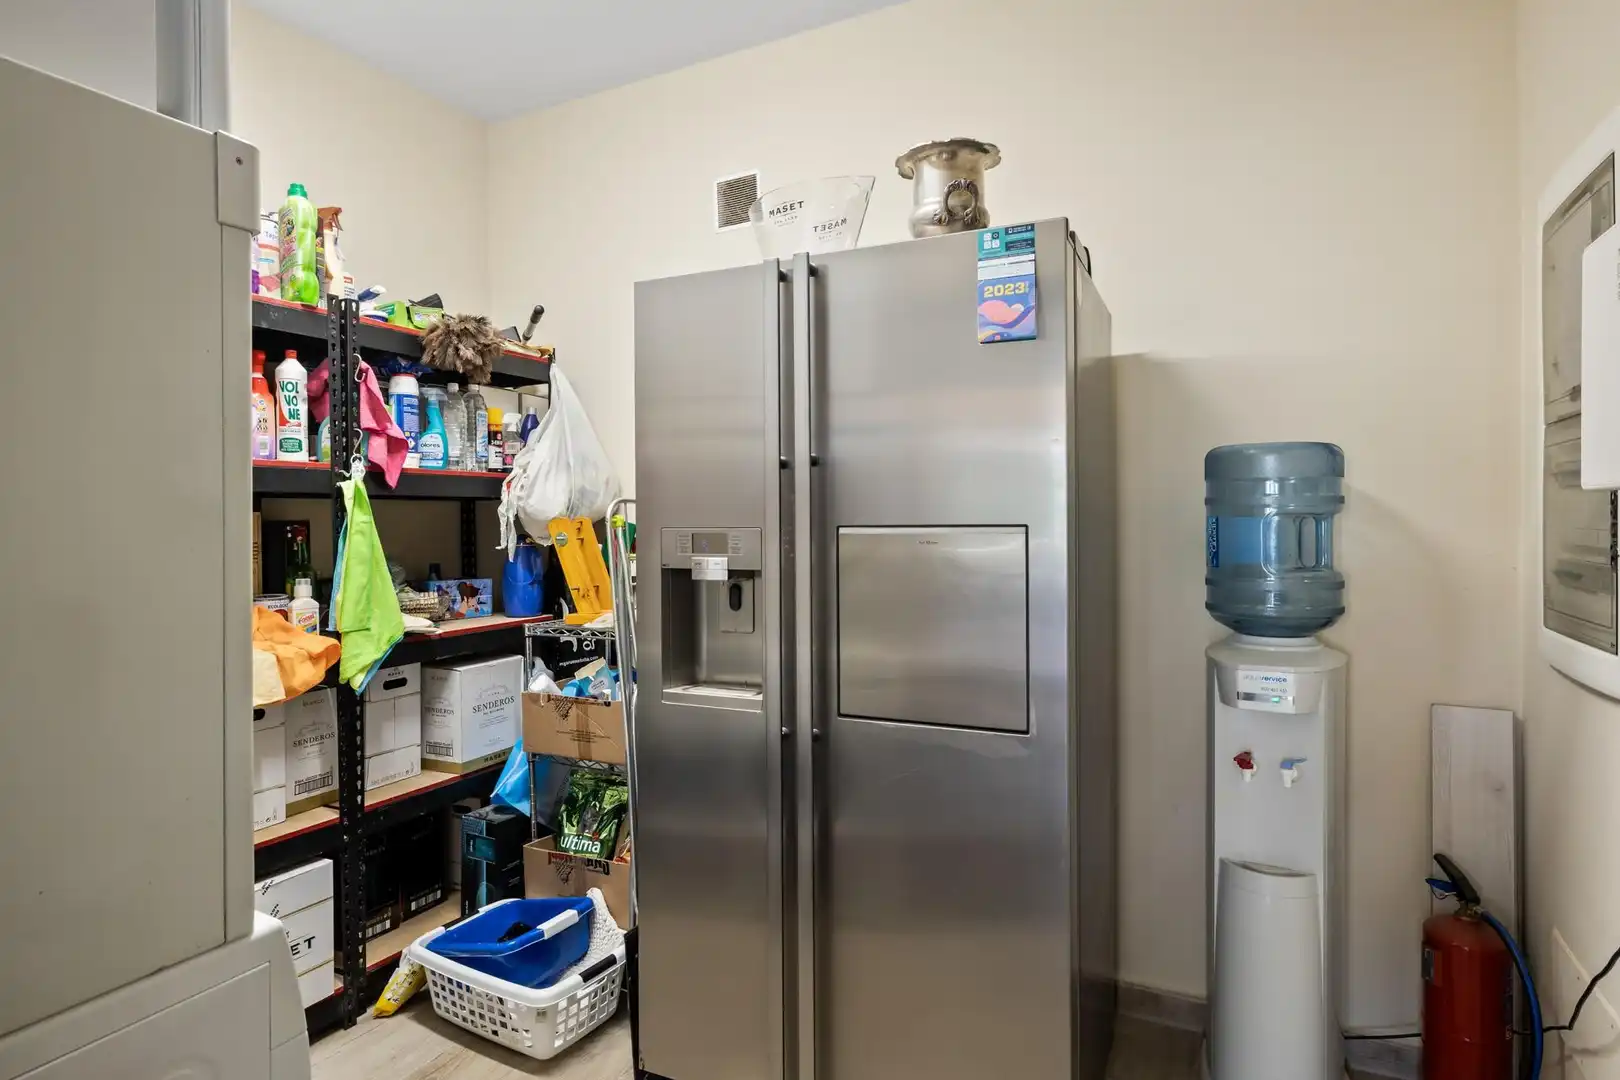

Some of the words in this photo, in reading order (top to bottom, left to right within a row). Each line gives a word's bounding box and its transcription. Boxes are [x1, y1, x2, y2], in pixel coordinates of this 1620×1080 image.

[769, 200, 805, 218] MASET
[984, 281, 1026, 298] 2023
[279, 380, 299, 394] VOL
[284, 394, 298, 407] VO
[288, 407, 301, 421] NE
[472, 695, 516, 713] SENDEROS
[293, 731, 336, 748] SENDEROS
[560, 834, 601, 853] ultima
